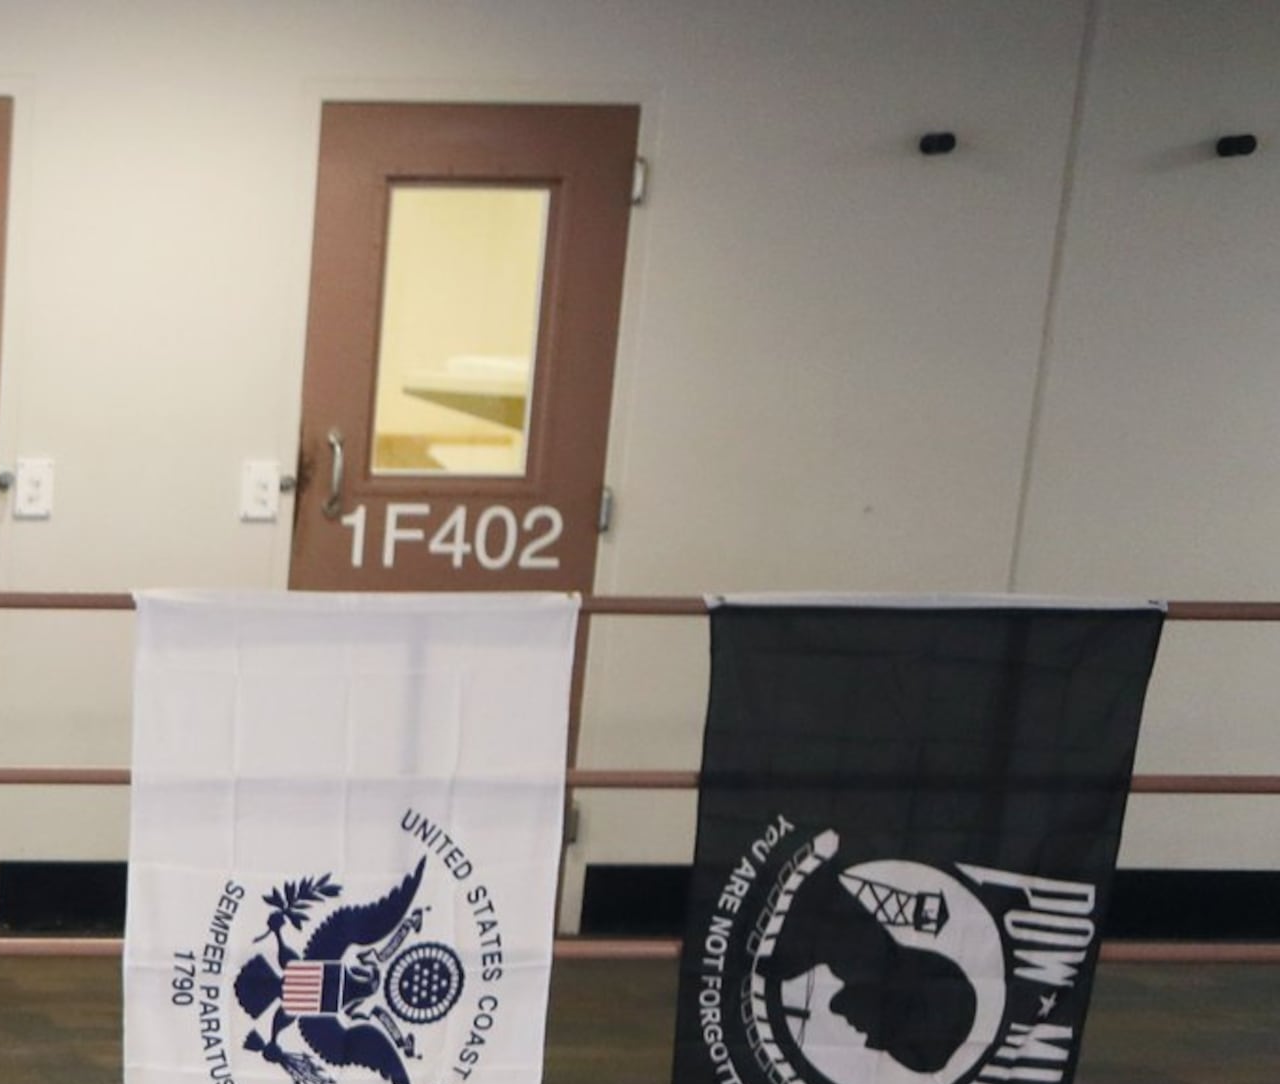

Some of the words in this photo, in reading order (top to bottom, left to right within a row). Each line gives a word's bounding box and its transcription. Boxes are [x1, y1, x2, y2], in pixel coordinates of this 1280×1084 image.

[340, 503, 563, 571] 1F402
[400, 807, 473, 881] UNITED
[751, 814, 795, 864] YOU
[718, 856, 757, 914] ARE
[200, 878, 245, 976] SEMPER
[467, 885, 503, 983] STATES
[701, 915, 734, 970] NOT
[954, 861, 1097, 988] POW
[171, 950, 196, 1007] 1790
[453, 995, 498, 1081] COAST
